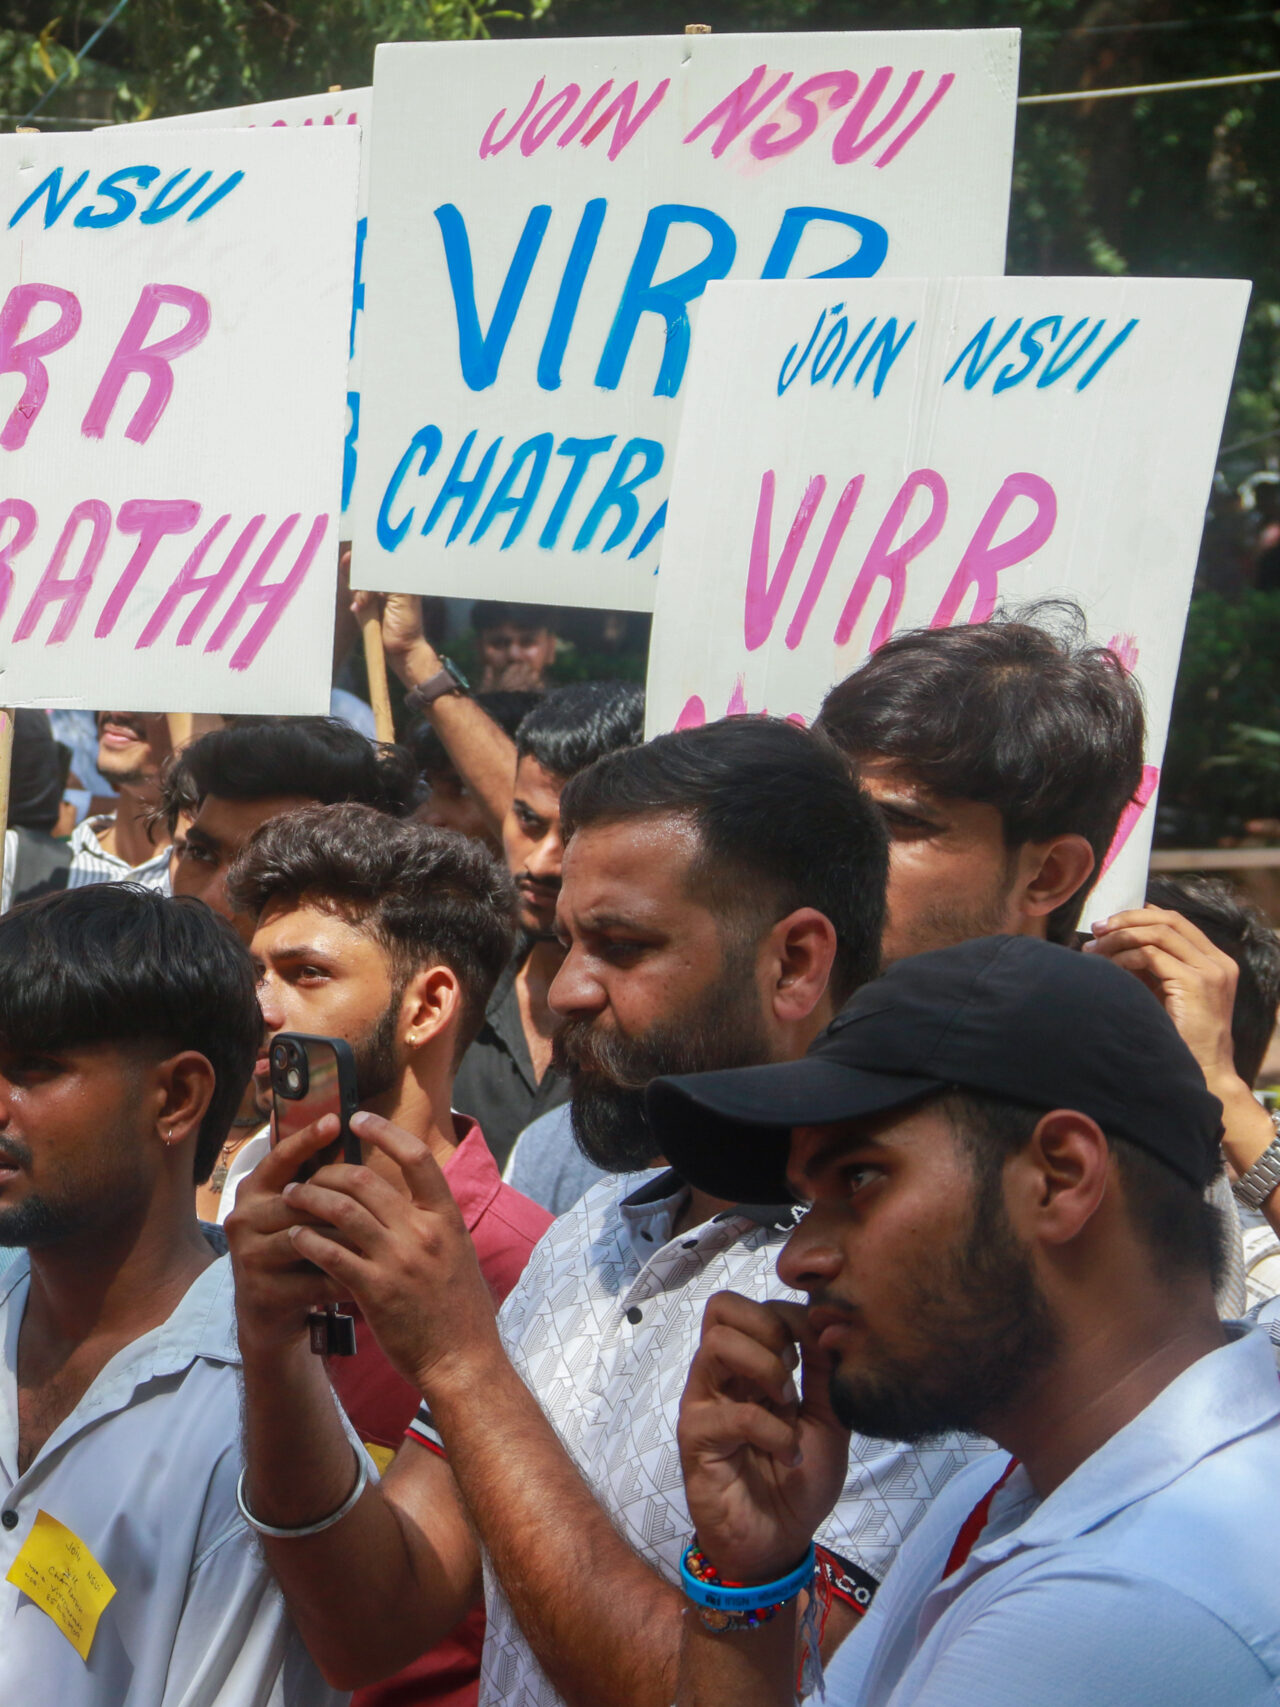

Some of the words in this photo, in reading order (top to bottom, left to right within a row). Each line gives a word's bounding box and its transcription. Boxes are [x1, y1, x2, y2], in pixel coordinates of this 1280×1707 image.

[481, 76, 669, 161] JOIN
[684, 64, 955, 168] NSUI
[8, 165, 246, 230] NSUI
[777, 302, 918, 399] JOIN
[944, 314, 1140, 398] NSUI
[744, 468, 1057, 652] VIRR
